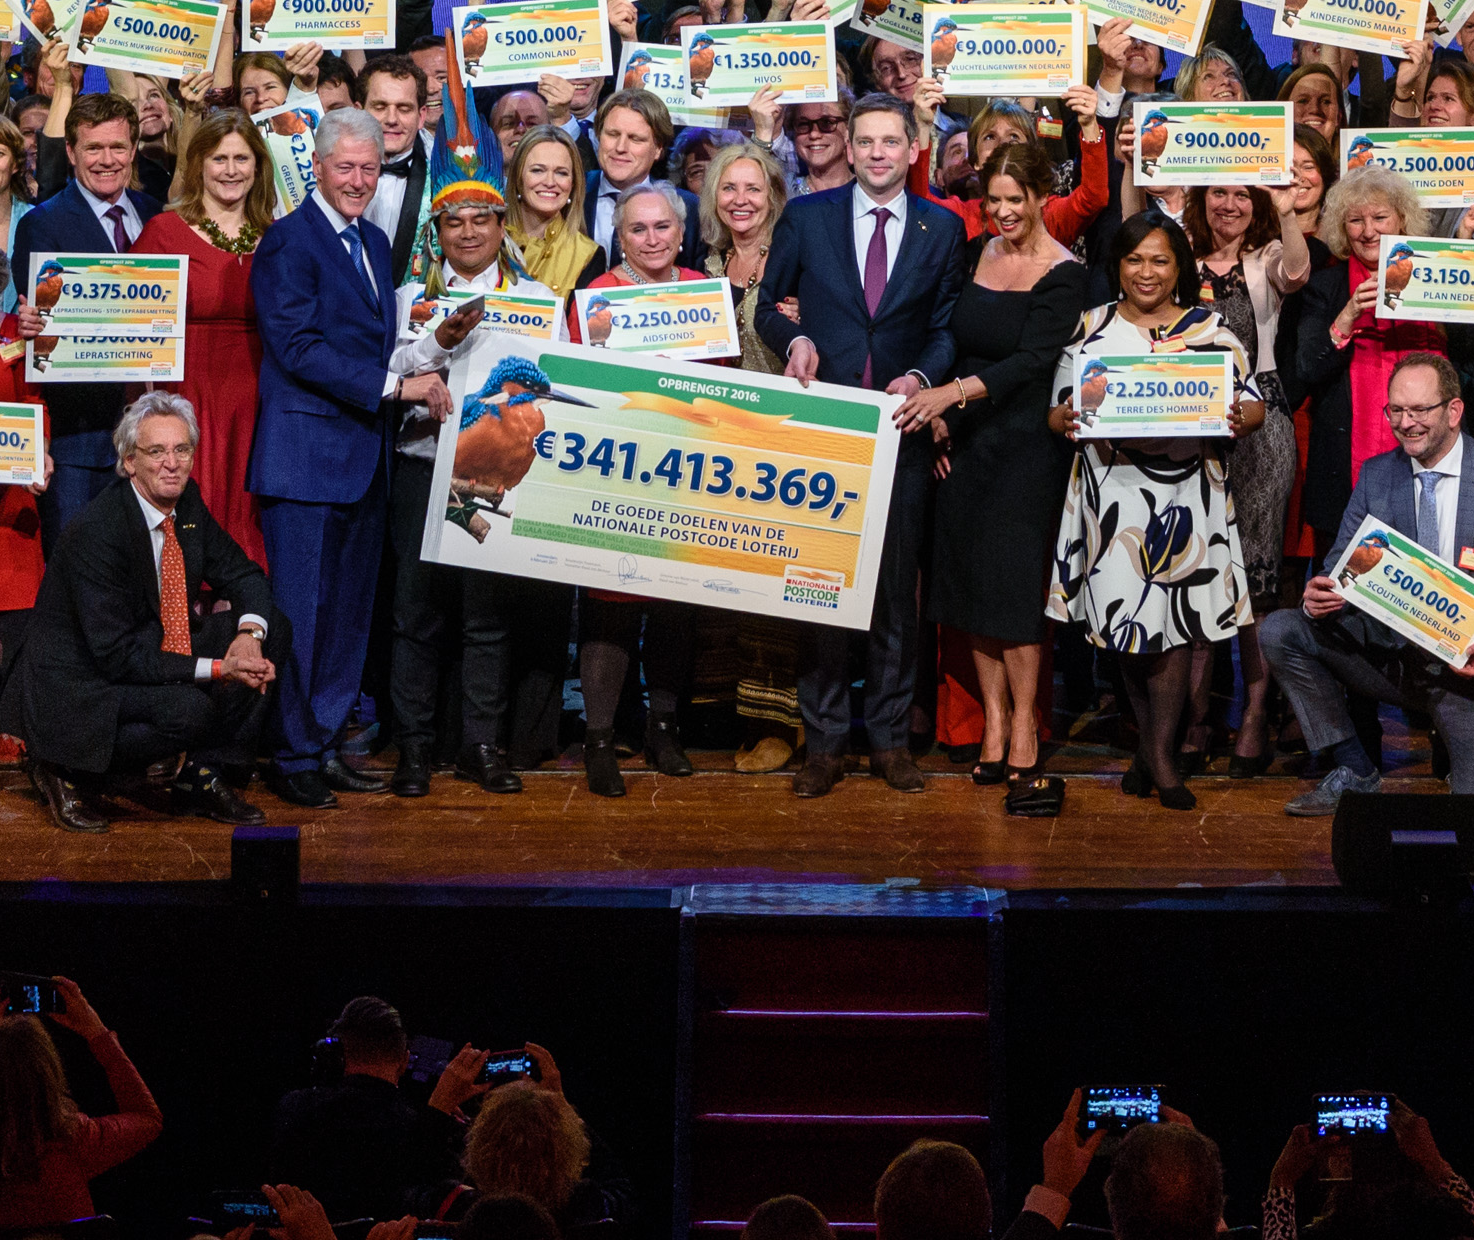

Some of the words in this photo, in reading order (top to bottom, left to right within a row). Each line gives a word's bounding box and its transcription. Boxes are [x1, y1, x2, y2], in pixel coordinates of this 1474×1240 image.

[113, 16, 200, 43] €500.000,-
[294, 20, 362, 29] PHARMACCESS
[1310, 11, 1372, 30] KINDERFONDS
[495, 25, 587, 46] €500.000,-
[508, 48, 577, 62] COMMONLAND
[956, 39, 1067, 57] €9.000.000,-
[713, 51, 821, 68] €1.350.000,-
[1174, 131, 1271, 151] €900.000,-
[1165, 156, 1198, 166] AMREF
[1200, 155, 1235, 165] FLYING
[1236, 154, 1279, 165] DOCTORS
[1438, 179, 1464, 188] DOEN
[62, 283, 172, 302] €9.375.000,-
[1423, 292, 1447, 302] PLAN
[611, 305, 722, 330] €2.250.000,-
[642, 330, 696, 344] AIDSFONDS
[74, 351, 154, 360] LEPRASTICHTING
[657, 376, 727, 397] OPBRENGST
[729, 386, 761, 403] 2016:
[1105, 379, 1220, 402] €2.250.000,-
[1115, 404, 1144, 414] TERRE
[1167, 403, 1209, 414] HOMMES
[533, 429, 859, 521] €341.413.369,-
[591, 499, 611, 513] DE
[613, 502, 666, 521] GOEDE
[669, 507, 731, 529] DOELEN
[732, 516, 763, 534] VAN
[766, 527, 786, 541] DE
[572, 512, 655, 537] NATIONALE
[660, 523, 738, 547] POSTCODE
[742, 538, 800, 559] LOTERIJ
[783, 584, 840, 603] POSTCODE
[790, 578, 836, 592] NATIONALE
[1383, 562, 1467, 627] €500.000,-
[1365, 579, 1410, 611] SCOUTING
[1408, 604, 1461, 642] NEDERLAND
